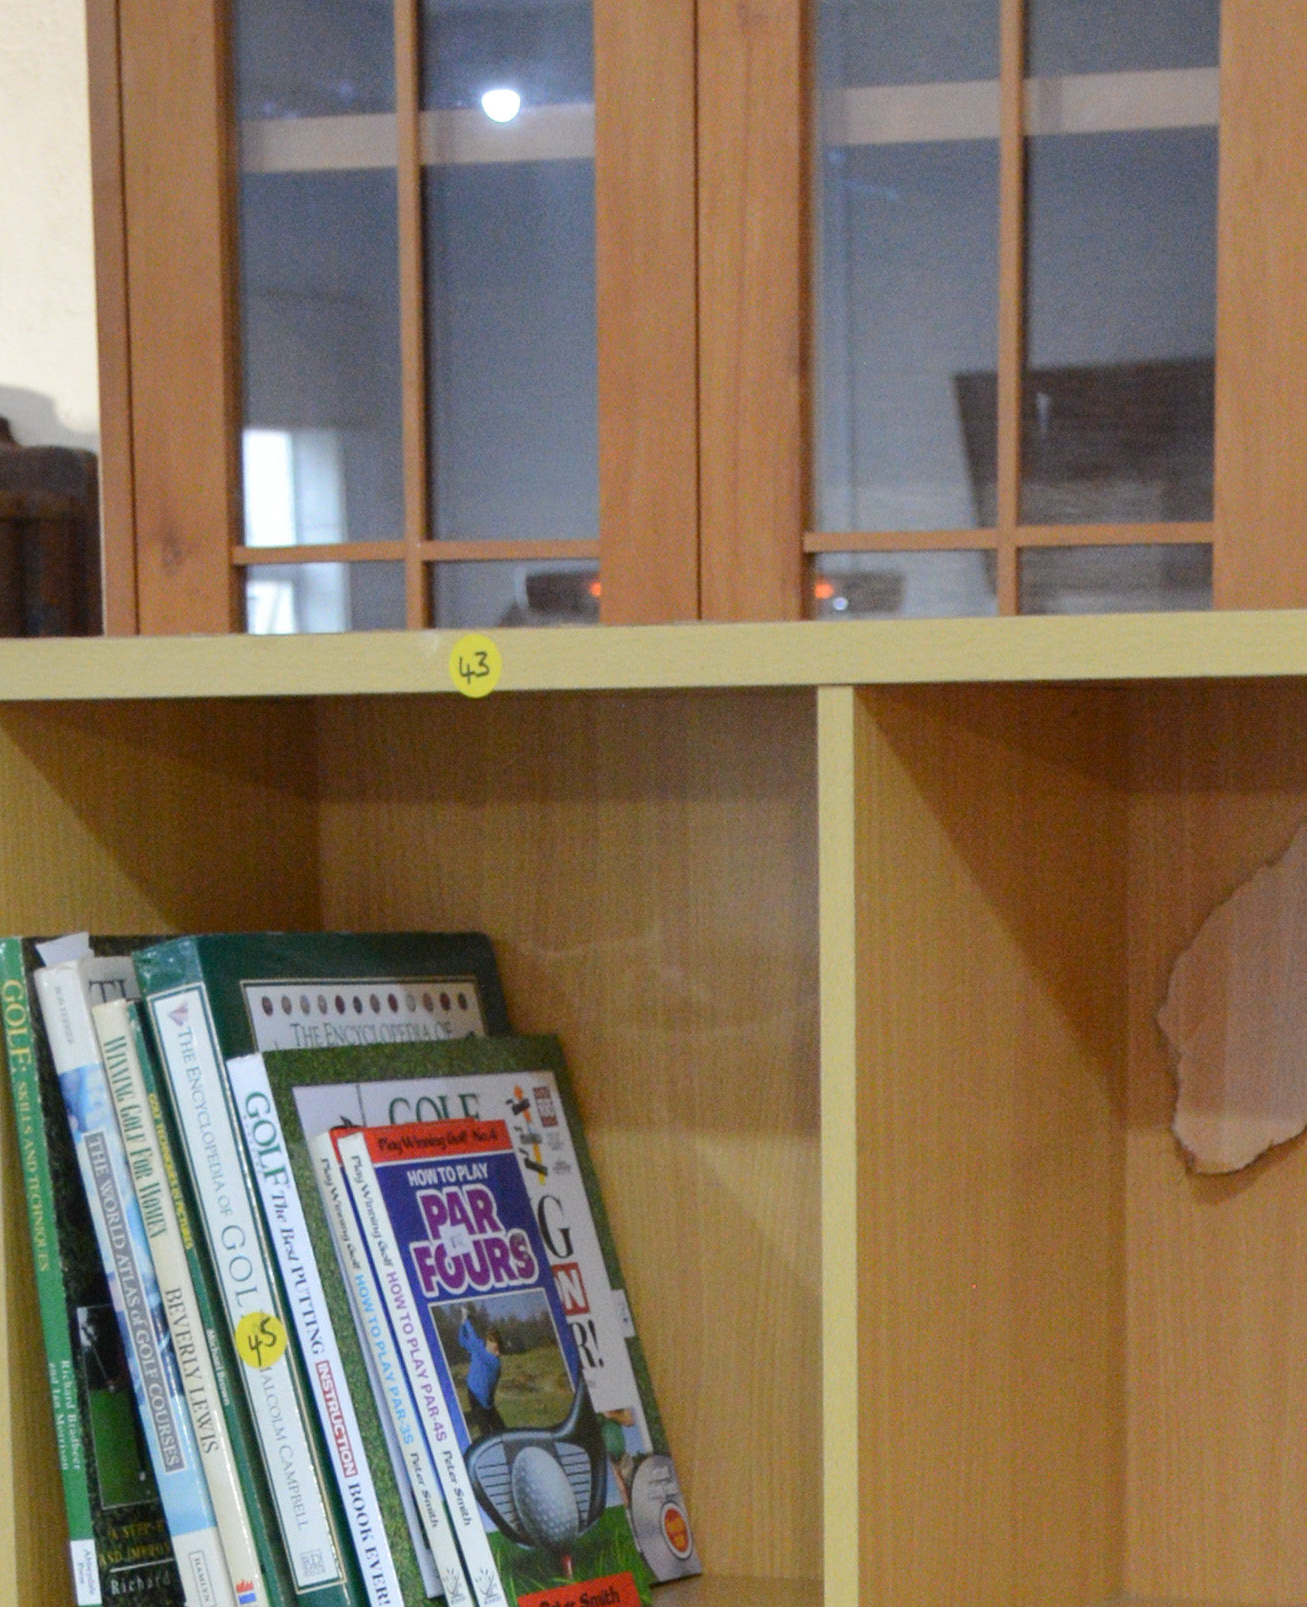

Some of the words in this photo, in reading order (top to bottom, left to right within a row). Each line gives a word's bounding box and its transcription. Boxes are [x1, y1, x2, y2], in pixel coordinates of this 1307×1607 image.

[457, 650, 491, 685] 43
[3, 978, 32, 1074] GOLF:
[177, 1028, 196, 1063] THE
[291, 1022, 321, 1047] THE
[324, 1023, 431, 1045] ENCYCLOPEDIA
[104, 1035, 129, 1103] WINNING
[16, 1081, 33, 1131] SKILLS
[120, 1104, 145, 1141] GOLF
[188, 1065, 226, 1192] ENCYCLOPEDIA
[23, 1140, 38, 1171] AND
[131, 1143, 153, 1181] FOR
[246, 1091, 289, 1185] GOLF
[379, 1137, 401, 1154] Play
[400, 1133, 445, 1152] Winning
[447, 1130, 468, 1148] Golf
[407, 1168, 439, 1187] HOW
[439, 1166, 454, 1183] TO
[454, 1162, 489, 1183] PLAY
[27, 1175, 49, 1272] TECHNIQUES
[139, 1181, 168, 1240] WOMEN
[216, 1194, 233, 1218] OF
[271, 1190, 286, 1224] The
[417, 1184, 503, 1241] PAR
[220, 1223, 263, 1314] GOL
[278, 1227, 299, 1262] Best
[410, 1229, 539, 1297] FOURS
[88, 1137, 109, 1176] THE
[101, 1179, 124, 1249] WORLD
[115, 1252, 138, 1310] ATLAS
[135, 1329, 156, 1377] GOLF
[148, 1380, 179, 1468] COURSES
[290, 1264, 324, 1356] PUTTING
[248, 1318, 277, 1367] 45
[321, 1158, 333, 1185] Play
[331, 1188, 350, 1243] Winning
[347, 1242, 361, 1269] Golf
[355, 1274, 373, 1311] HOW
[368, 1316, 382, 1338] TO
[375, 1339, 395, 1383] PLAY
[390, 1385, 414, 1445] PAR-3S
[411, 1453, 427, 1487] Peter
[422, 1488, 438, 1528] Smith
[351, 1155, 365, 1183] Play
[361, 1185, 382, 1238] Winning
[379, 1238, 393, 1266] Golf
[387, 1272, 407, 1308] HOW
[400, 1311, 413, 1335] TO
[410, 1338, 429, 1380] PLAY
[422, 1384, 447, 1442] PAR-4S
[443, 1451, 460, 1485] Peter
[453, 1486, 471, 1527] Smith
[49, 1363, 58, 1383] and
[60, 1361, 76, 1412] Richard
[165, 1287, 198, 1381] BEVERLY
[190, 1382, 219, 1455] LEWIS
[318, 1363, 355, 1475] INSTRUCTION
[275, 1444, 310, 1531] CAMPBELL
[348, 1483, 373, 1544] BOOK
[111, 1570, 170, 1595] Richard
[194, 1557, 210, 1602] HAMLYN
[364, 1546, 391, 1607] EVER!
